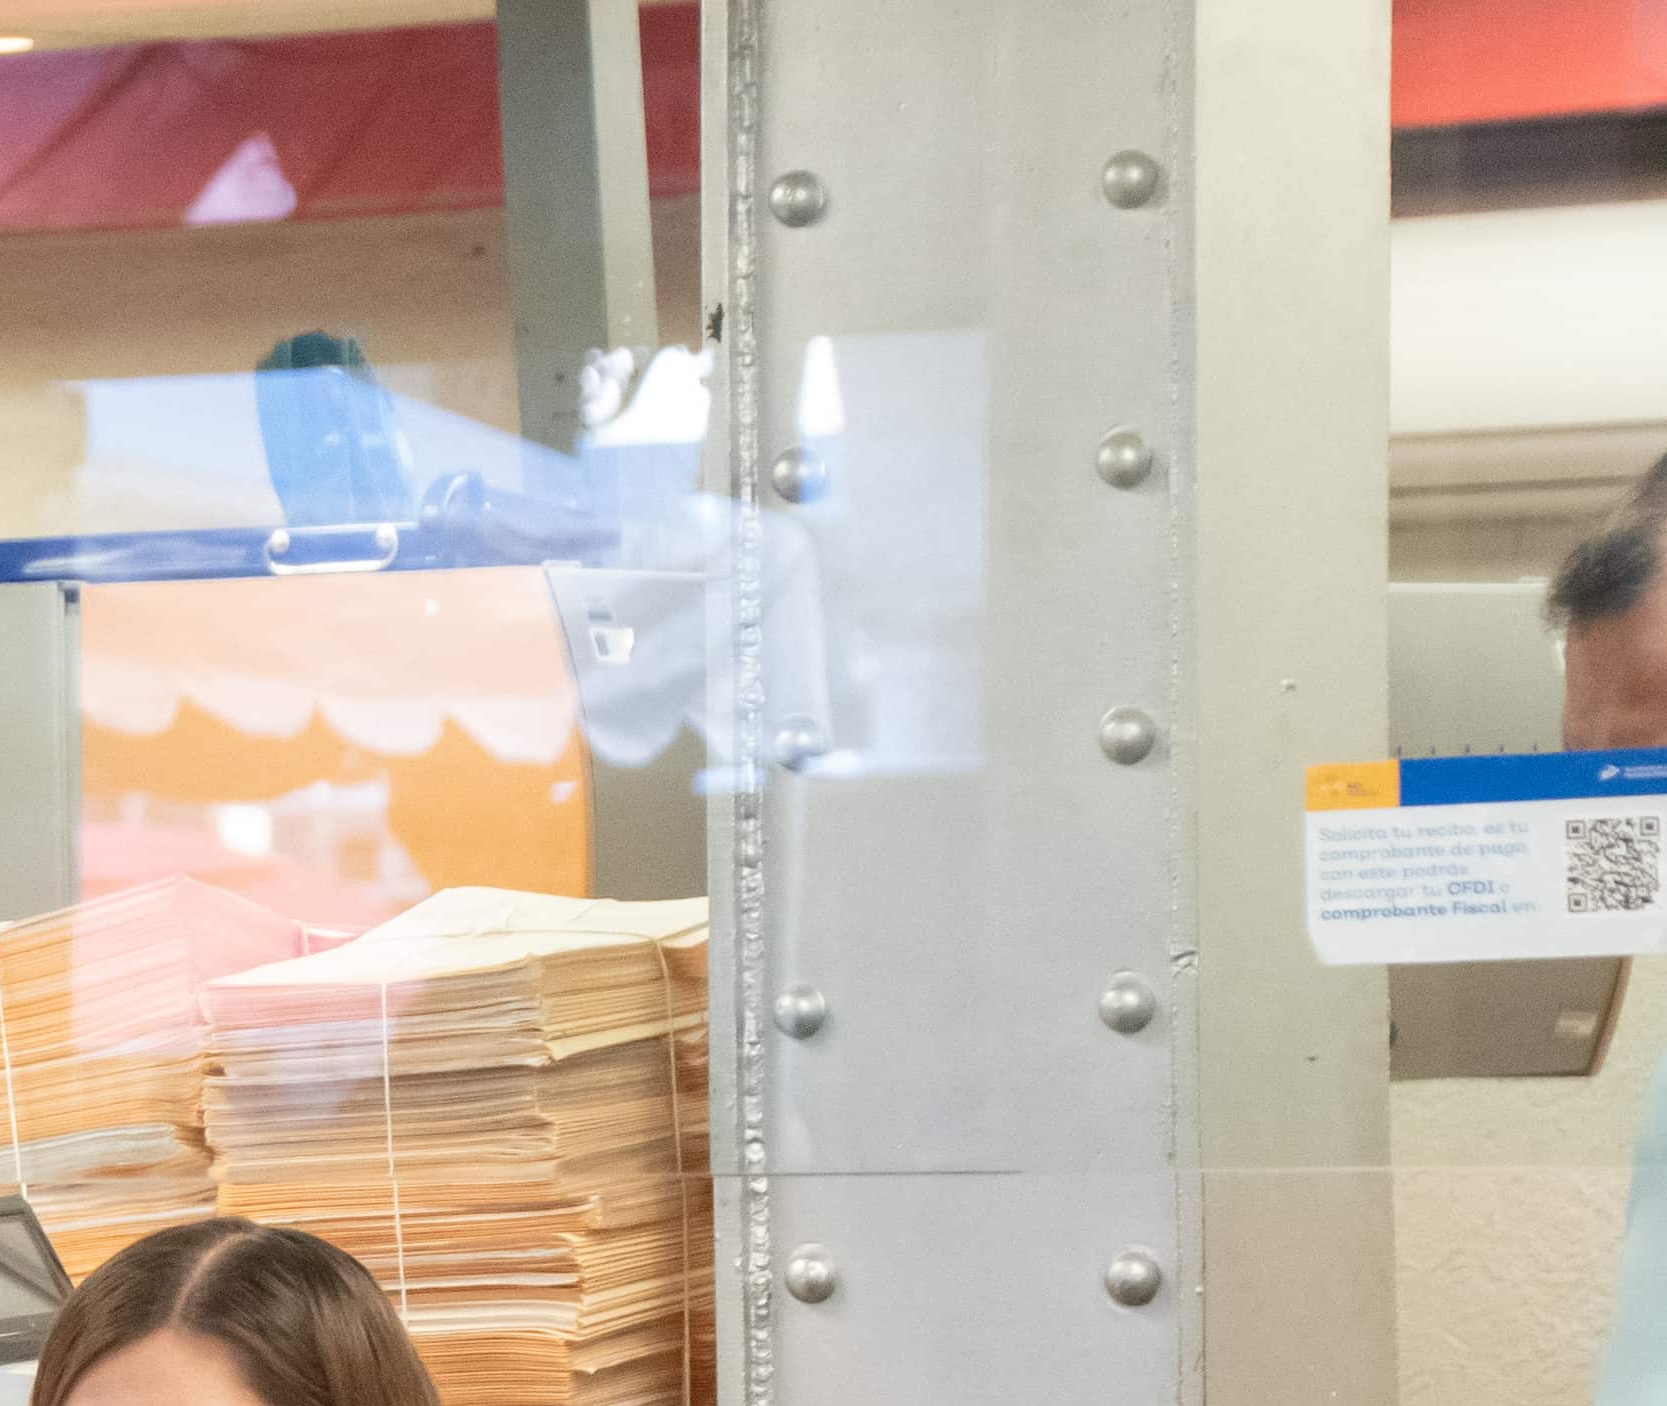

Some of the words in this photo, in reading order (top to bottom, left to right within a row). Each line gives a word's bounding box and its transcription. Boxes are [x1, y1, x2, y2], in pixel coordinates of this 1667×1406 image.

[1393, 826, 1411, 838] tu
[1509, 820, 1528, 833] tu
[1450, 842, 1474, 856] de
[1447, 880, 1494, 895] CFDI
[1321, 902, 1447, 920] comprobante
[1452, 900, 1507, 914] Fiscal
